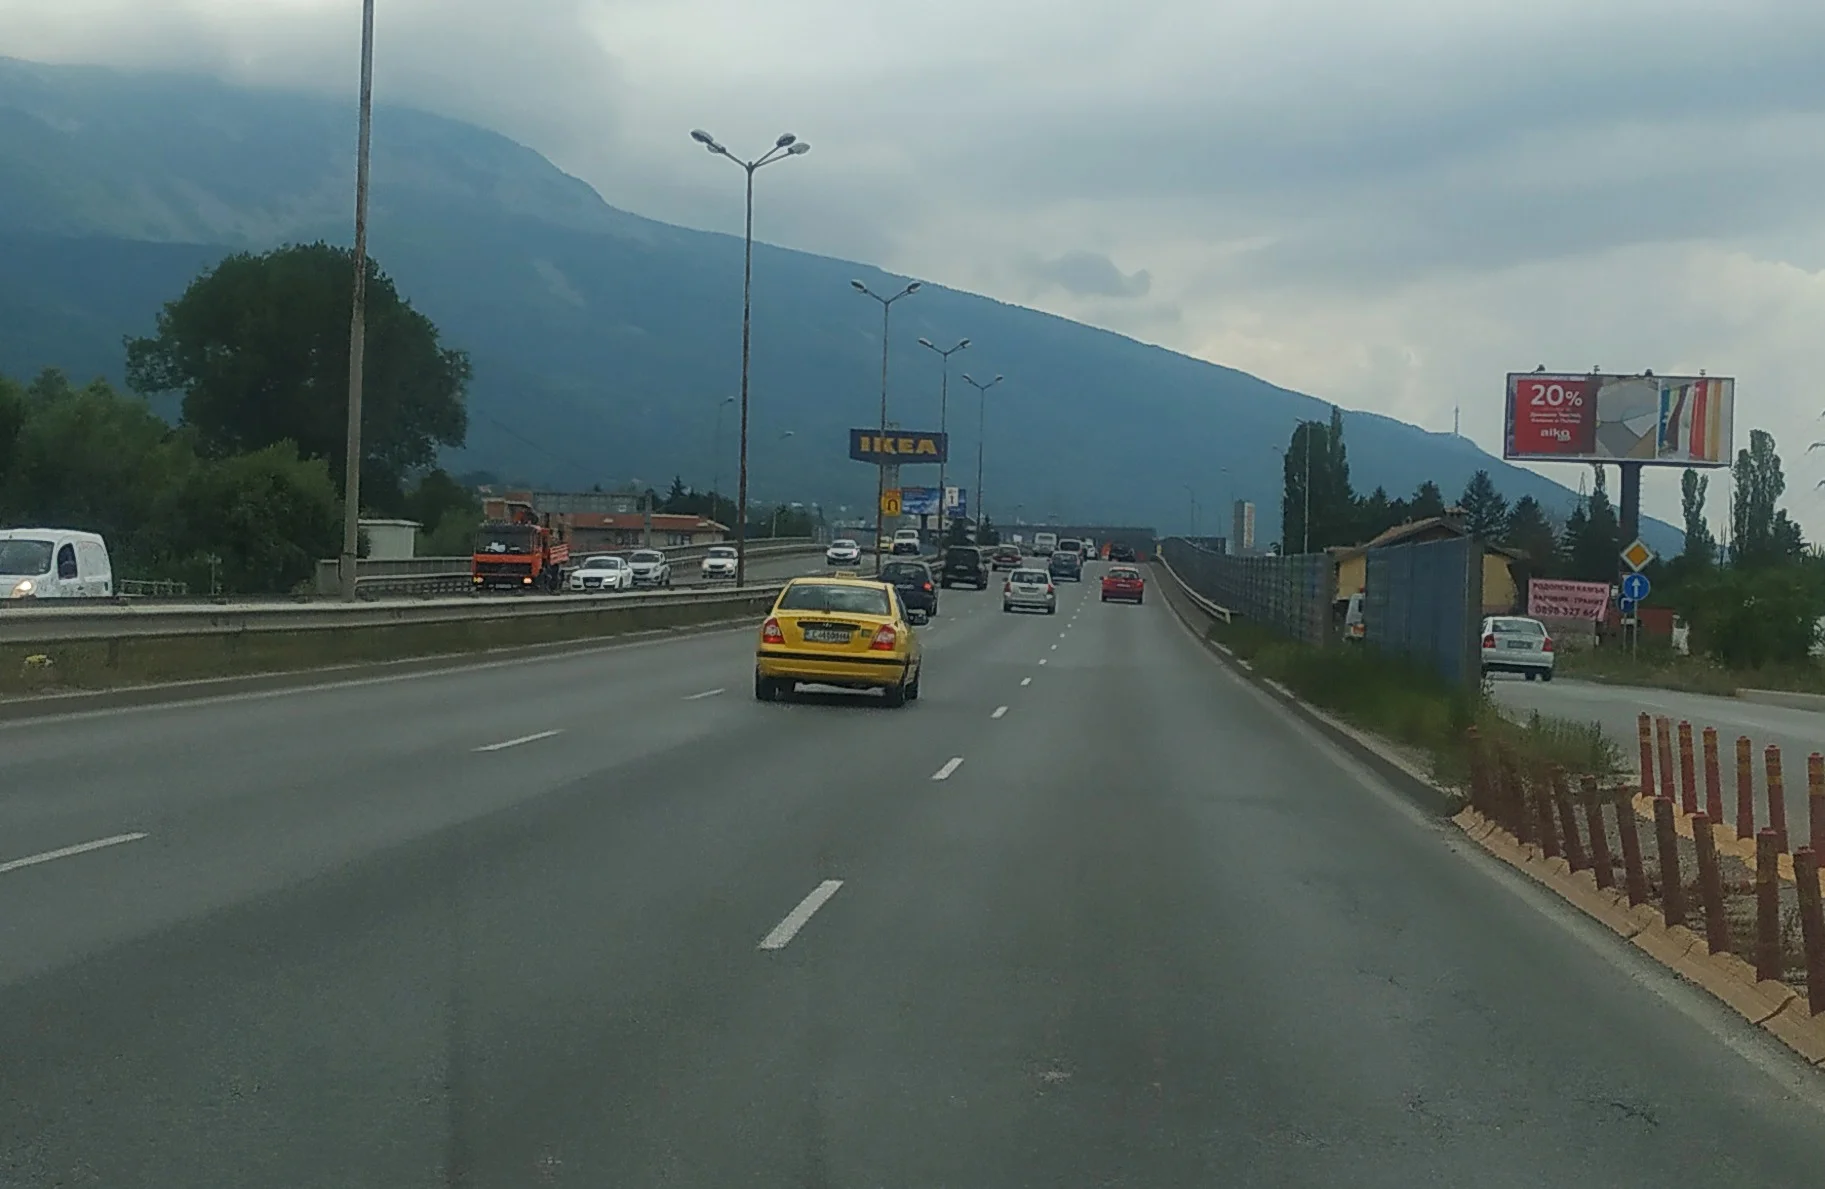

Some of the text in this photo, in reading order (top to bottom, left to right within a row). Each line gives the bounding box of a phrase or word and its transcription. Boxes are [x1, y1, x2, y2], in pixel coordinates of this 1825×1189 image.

[1530, 384, 1583, 407] 20%
[1540, 427, 1571, 438] aiko
[860, 436, 938, 456] IKEA
